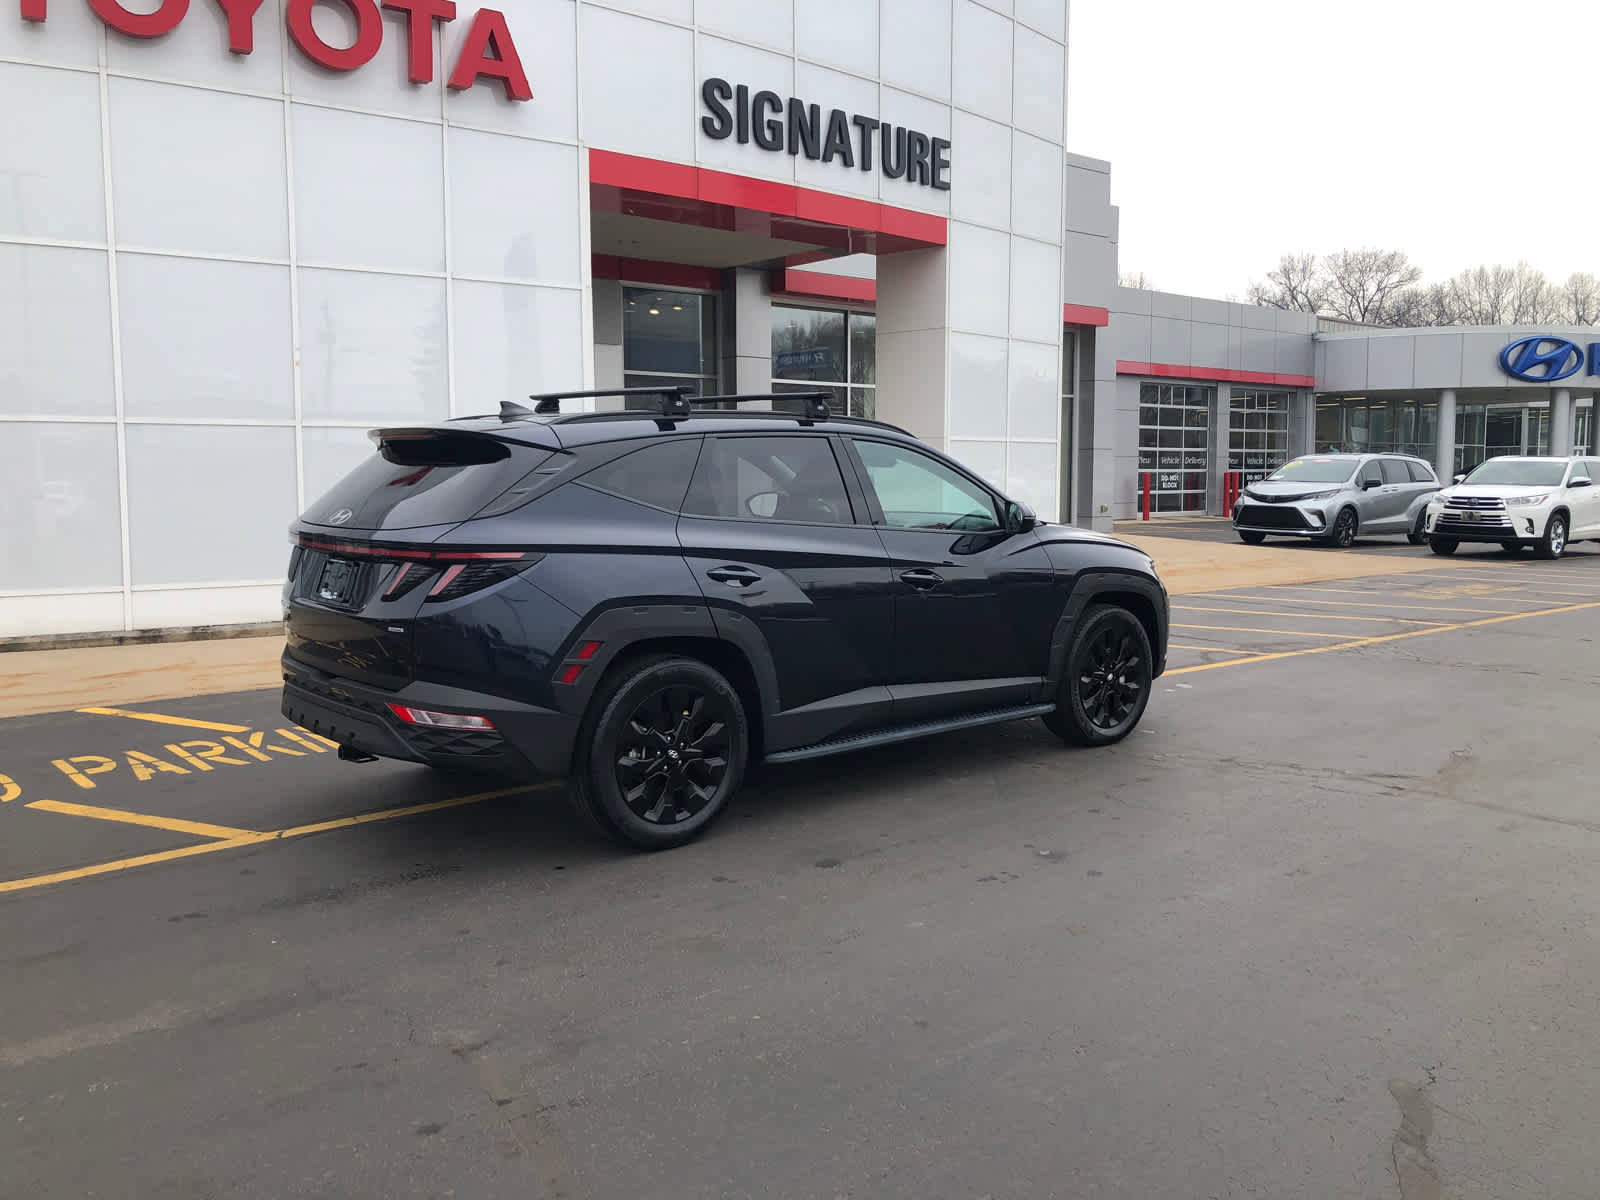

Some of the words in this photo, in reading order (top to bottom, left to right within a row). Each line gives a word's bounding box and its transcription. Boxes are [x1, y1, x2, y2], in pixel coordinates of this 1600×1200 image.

[20, 0, 534, 102] YOTA
[701, 77, 952, 191] SIGNATURE
[1161, 456, 1180, 465] Vehicle
[1184, 456, 1206, 466] Delivery
